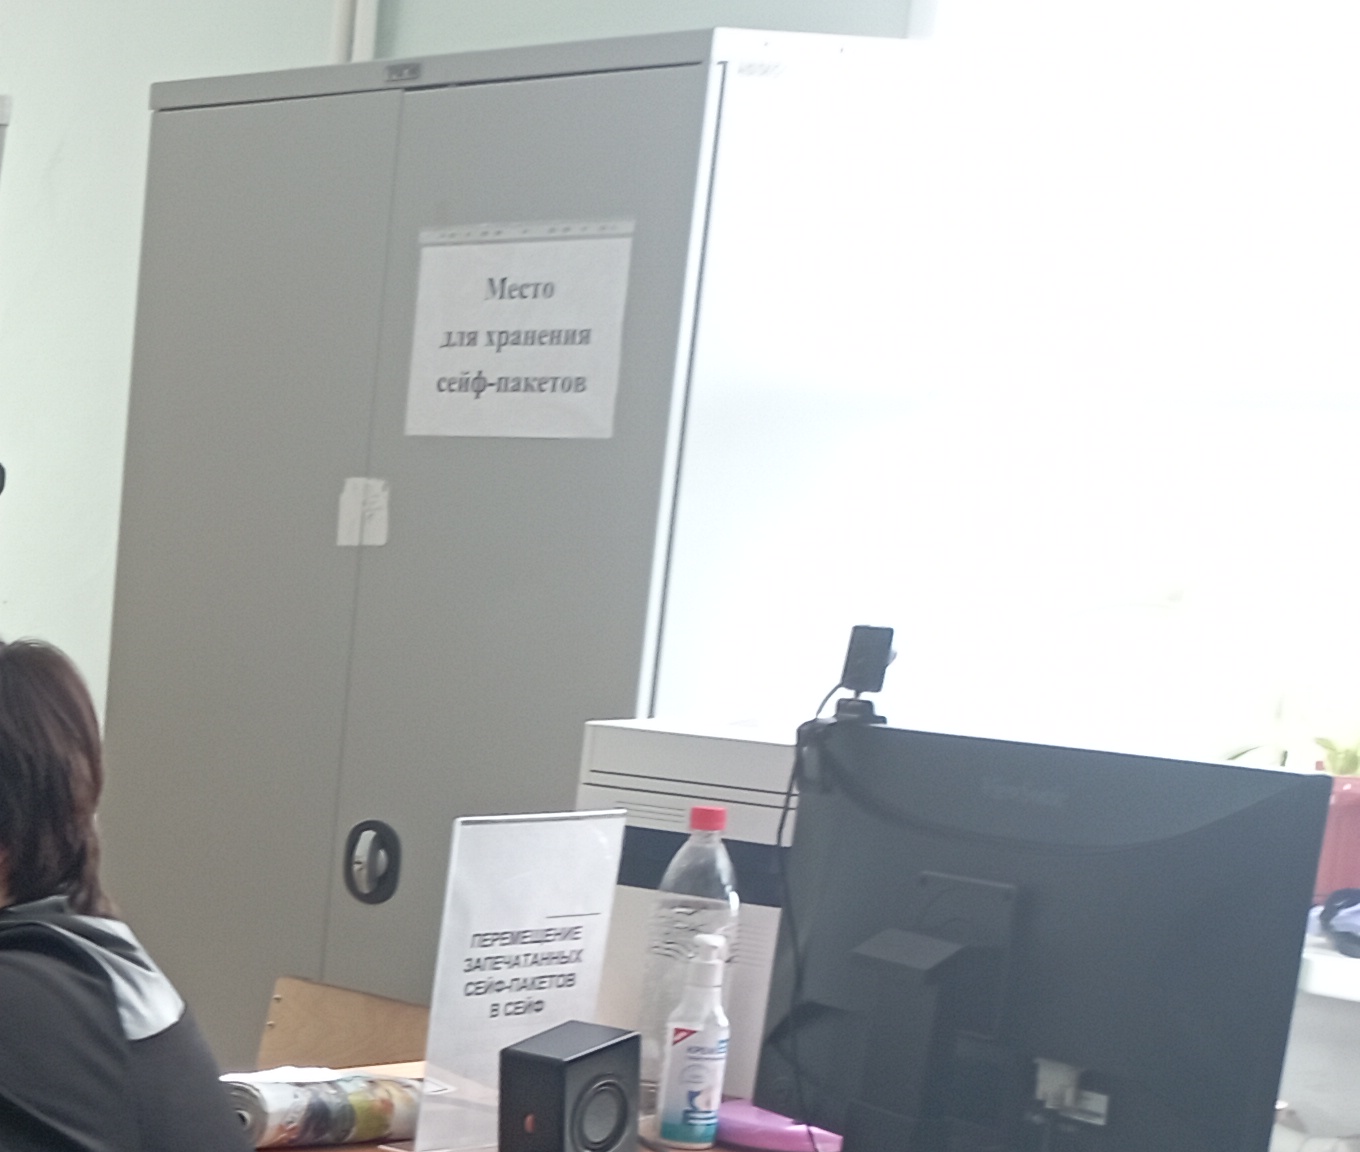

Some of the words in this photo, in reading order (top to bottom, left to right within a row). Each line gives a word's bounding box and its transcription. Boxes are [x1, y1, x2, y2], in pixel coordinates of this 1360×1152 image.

[484, 276, 556, 301] Место
[439, 329, 480, 349] для
[483, 328, 593, 354] хранения
[436, 370, 589, 400] сейф-пакетов
[470, 925, 584, 948] ПЕРЕМЕЩЕНИЕ
[463, 949, 585, 973] ЗАПЕЧАТАННЫХ
[464, 972, 577, 997] СЕЙФ-ПАКЕТОВ
[489, 1002, 500, 1018] В
[503, 996, 545, 1017] СЕЙФ
